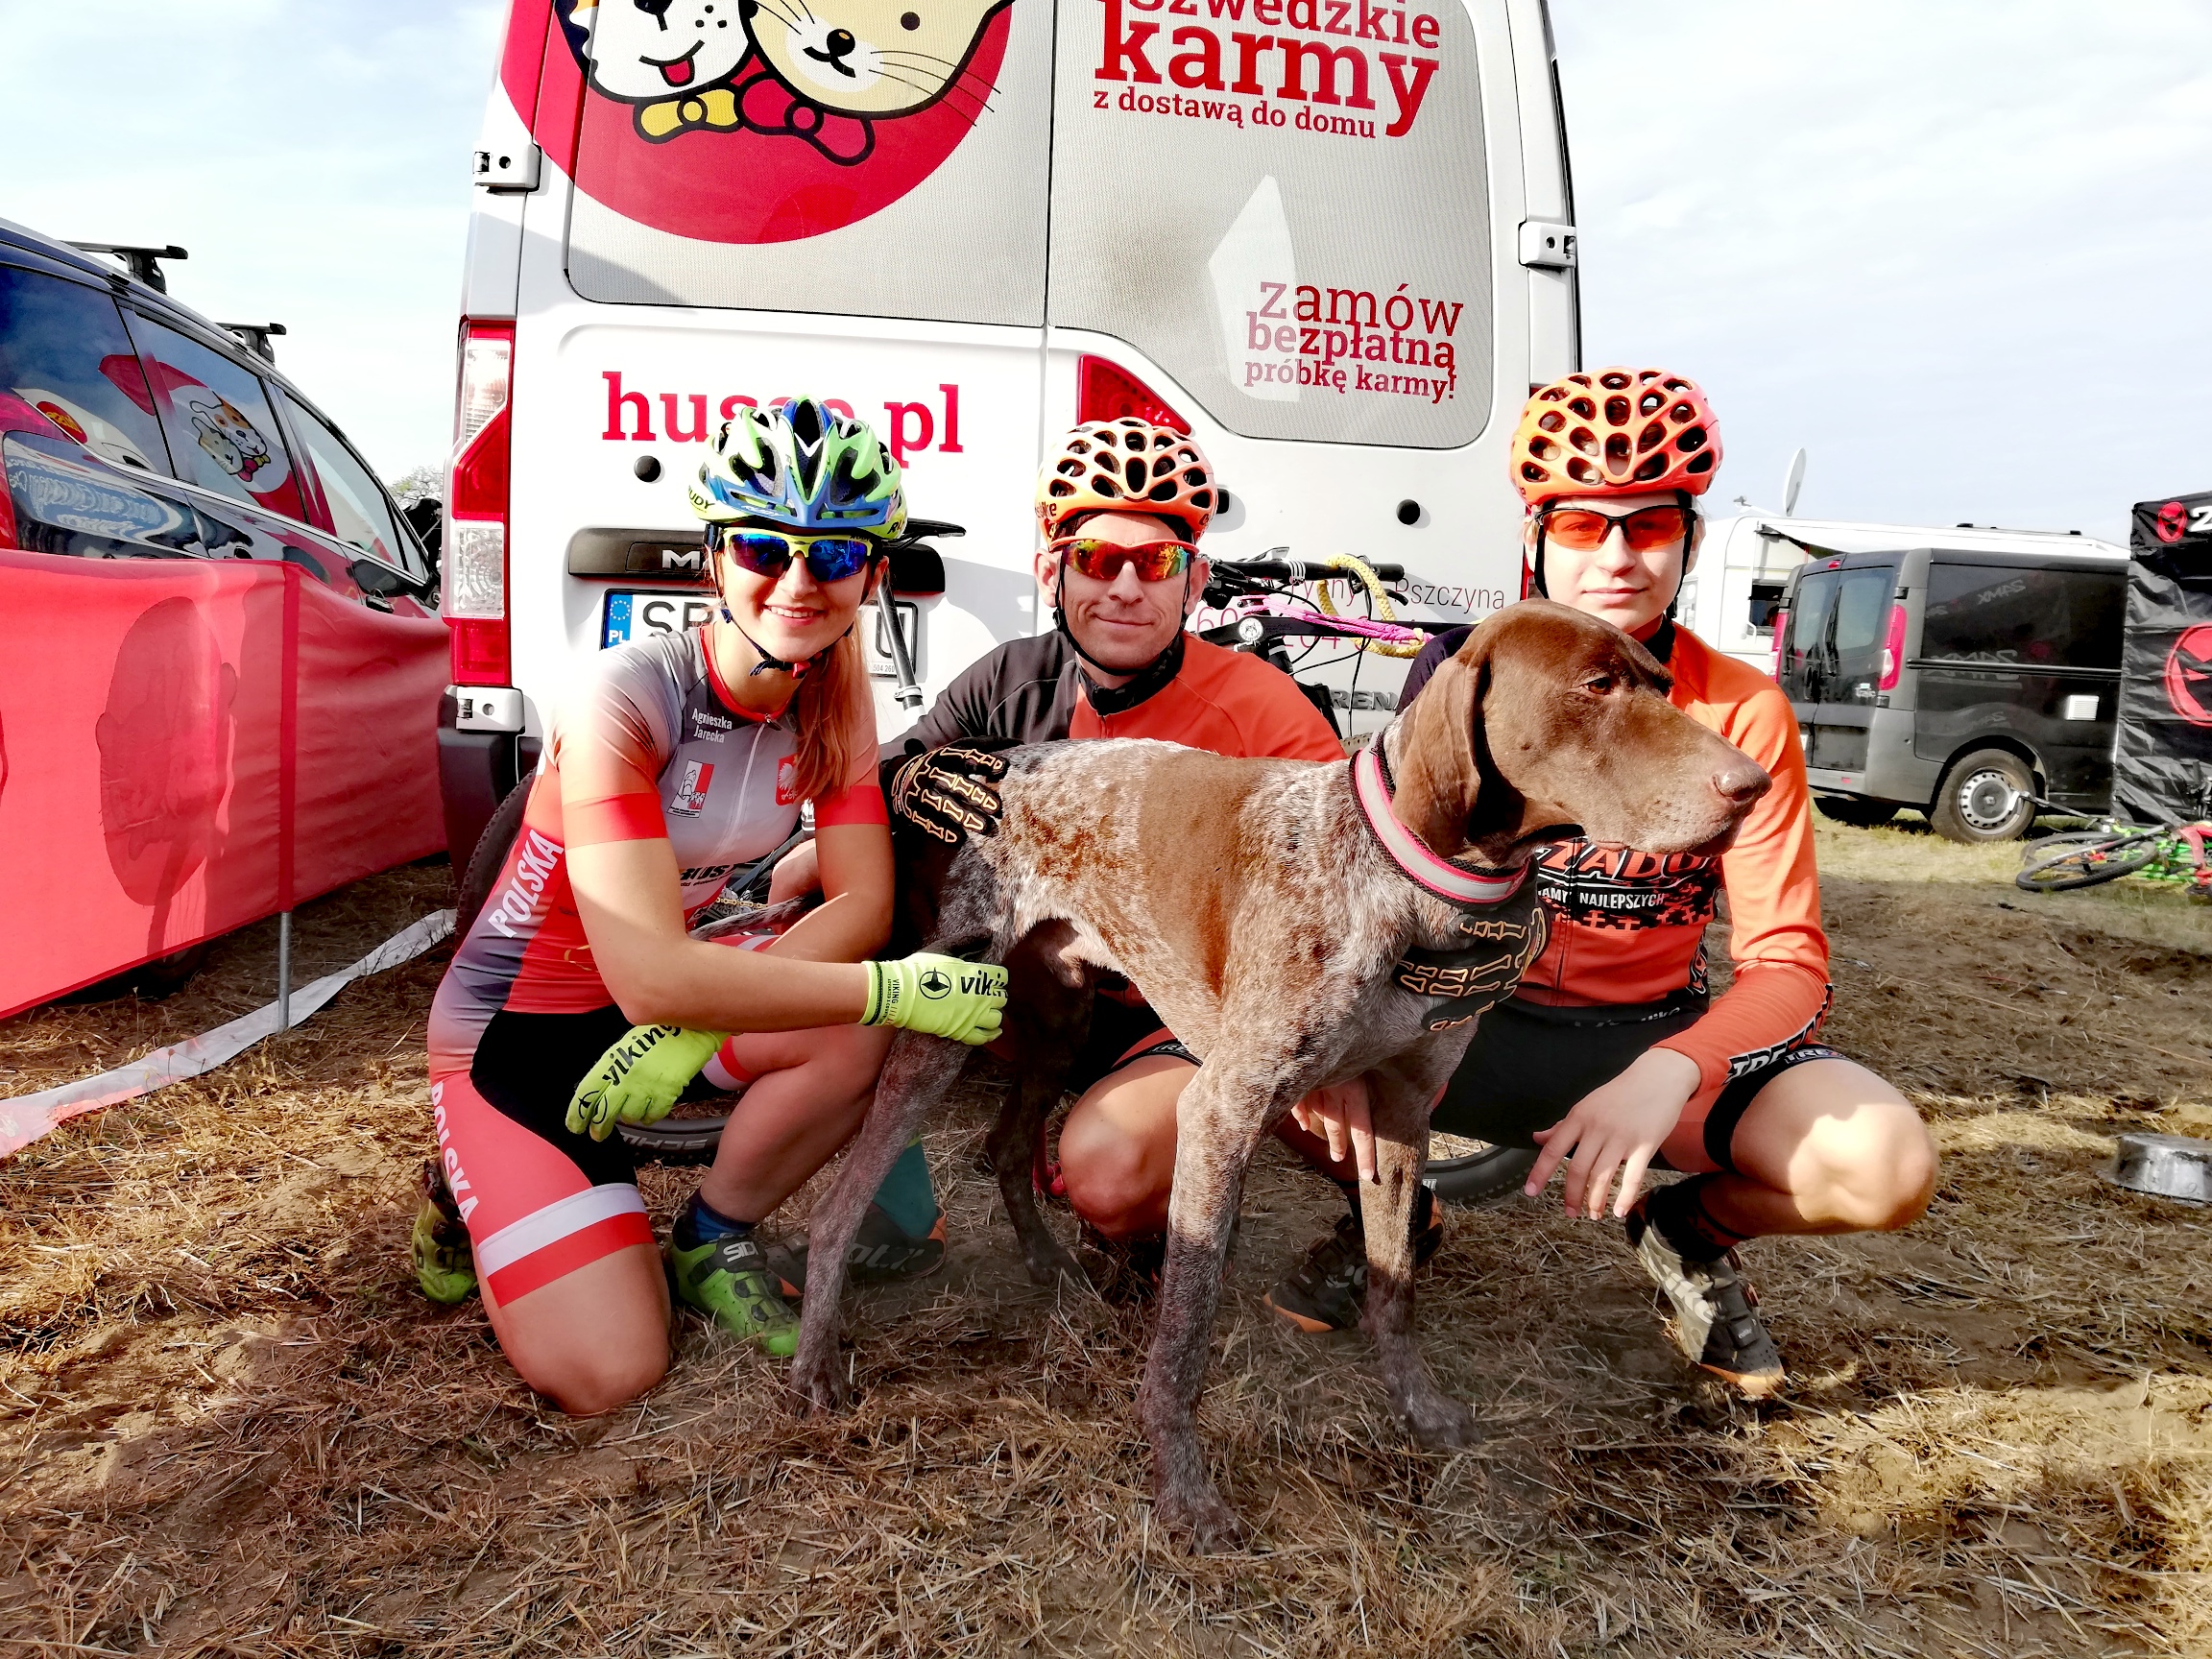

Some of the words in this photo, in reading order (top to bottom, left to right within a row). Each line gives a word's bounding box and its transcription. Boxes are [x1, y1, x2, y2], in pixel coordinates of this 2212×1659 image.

[1130, 0, 1440, 49] zwedzkie
[1094, 0, 1440, 137] karmy
[1094, 90, 1109, 108] z
[1118, 86, 1244, 129] dostawą
[1251, 101, 1286, 127] do
[1295, 106, 1377, 138] domu
[1259, 281, 1464, 337] zamów
[1246, 311, 1455, 376] bezpłatną
[1244, 358, 1347, 394] próbkę
[1356, 364, 1456, 404] karmy!
[602, 371, 964, 469] hupl
[661, 550, 704, 570] M
[608, 630, 627, 643] PL
[691, 708, 733, 730] Agnieszka
[1333, 689, 1399, 711] REN
[693, 725, 725, 743] Jarecka
[487, 829, 565, 939] POLSKA
[1579, 892, 1666, 910] NAJLEPSZYCH
[891, 978, 901, 1004] VIKING
[430, 1081, 479, 1224] POLSKA
